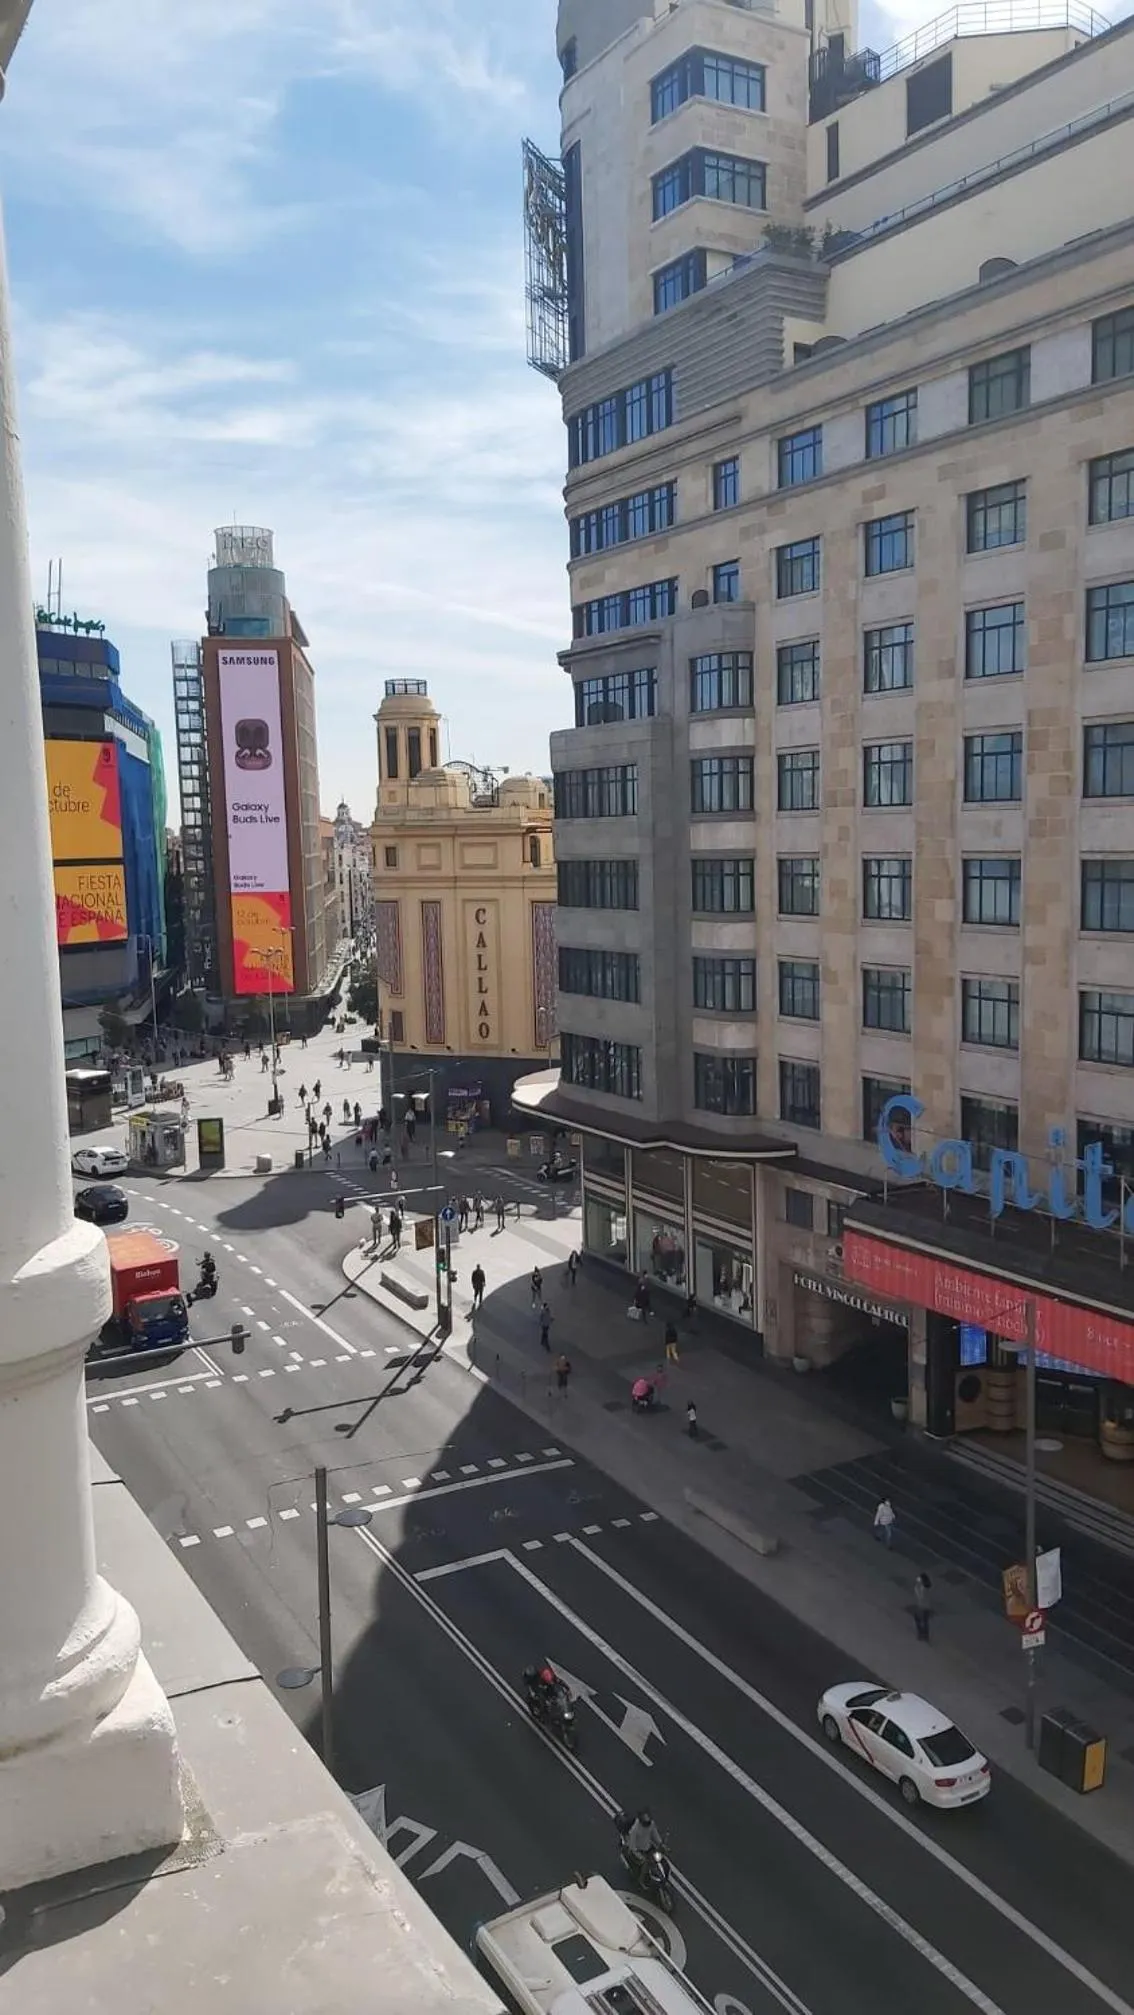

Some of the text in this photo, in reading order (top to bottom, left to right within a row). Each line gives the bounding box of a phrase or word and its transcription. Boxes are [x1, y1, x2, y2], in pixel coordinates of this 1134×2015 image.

[222, 656, 275, 666] SAMSUNG
[53, 782, 71, 797] de
[232, 803, 269, 813] Galaxy
[232, 815, 280, 824] Buds Live
[79, 873, 121, 891] FIESTA
[475, 908, 490, 1039] CALLAO
